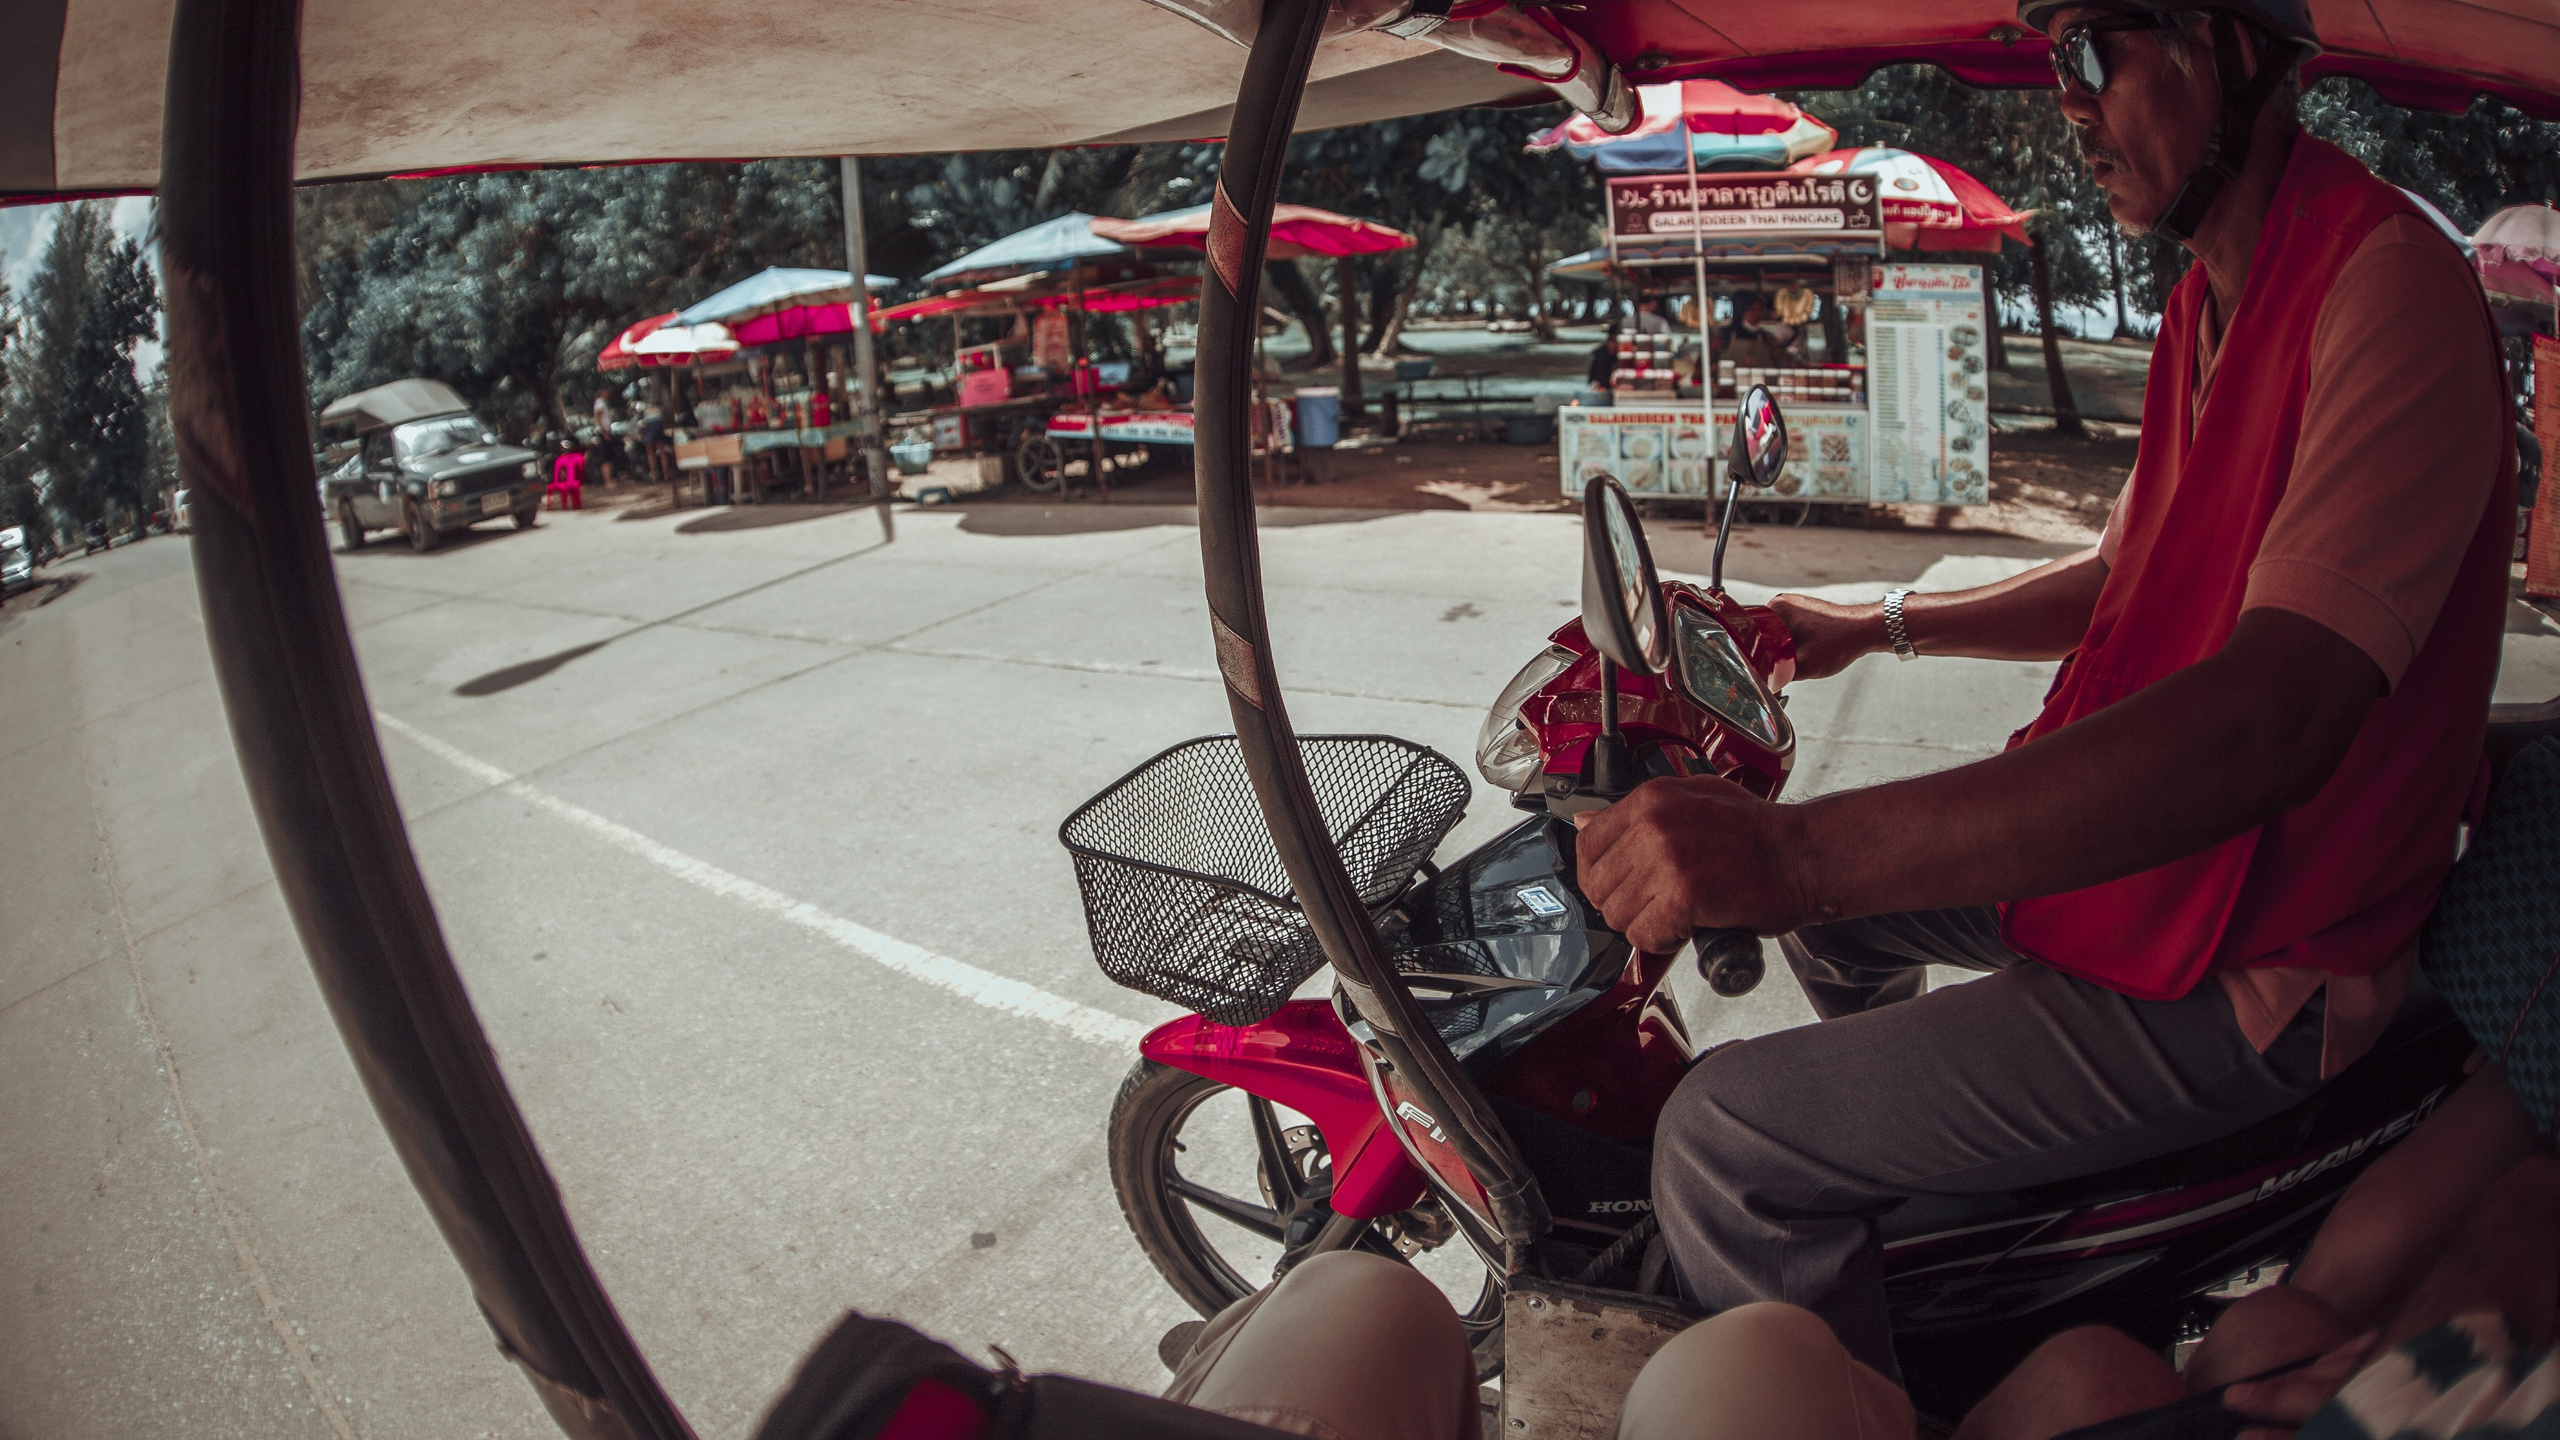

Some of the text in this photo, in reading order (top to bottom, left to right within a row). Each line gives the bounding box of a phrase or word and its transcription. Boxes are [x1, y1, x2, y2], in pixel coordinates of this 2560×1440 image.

[1654, 212, 1841, 228] SALARDDEEN THAI PANCAKE
[1681, 413, 1706, 425] THA
[1587, 1199, 1653, 1213] HON
